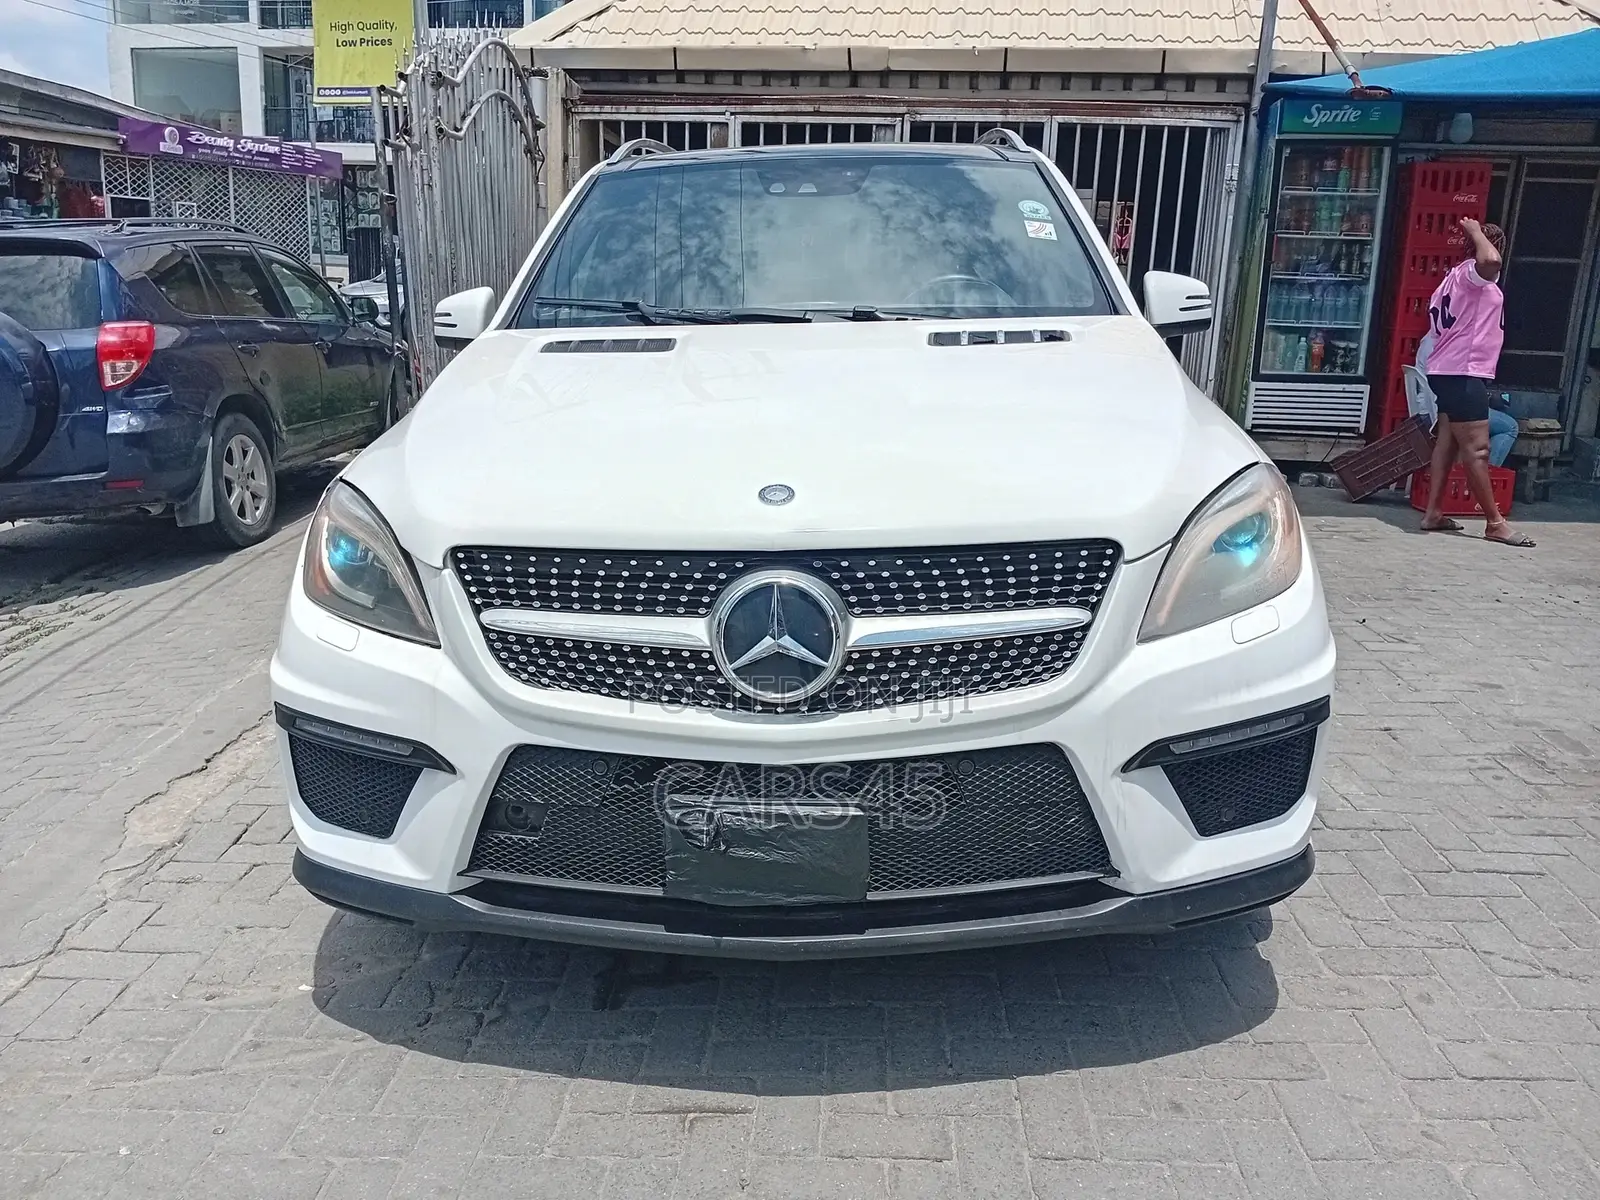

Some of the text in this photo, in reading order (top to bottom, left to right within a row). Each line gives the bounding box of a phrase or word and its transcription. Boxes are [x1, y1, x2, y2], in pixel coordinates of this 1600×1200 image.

[329, 20, 398, 35] High Quality,
[336, 37, 393, 47] Low Prices
[1303, 104, 1362, 127] Sprite
[186, 131, 235, 151] Beauty
[237, 139, 281, 154] Signature
